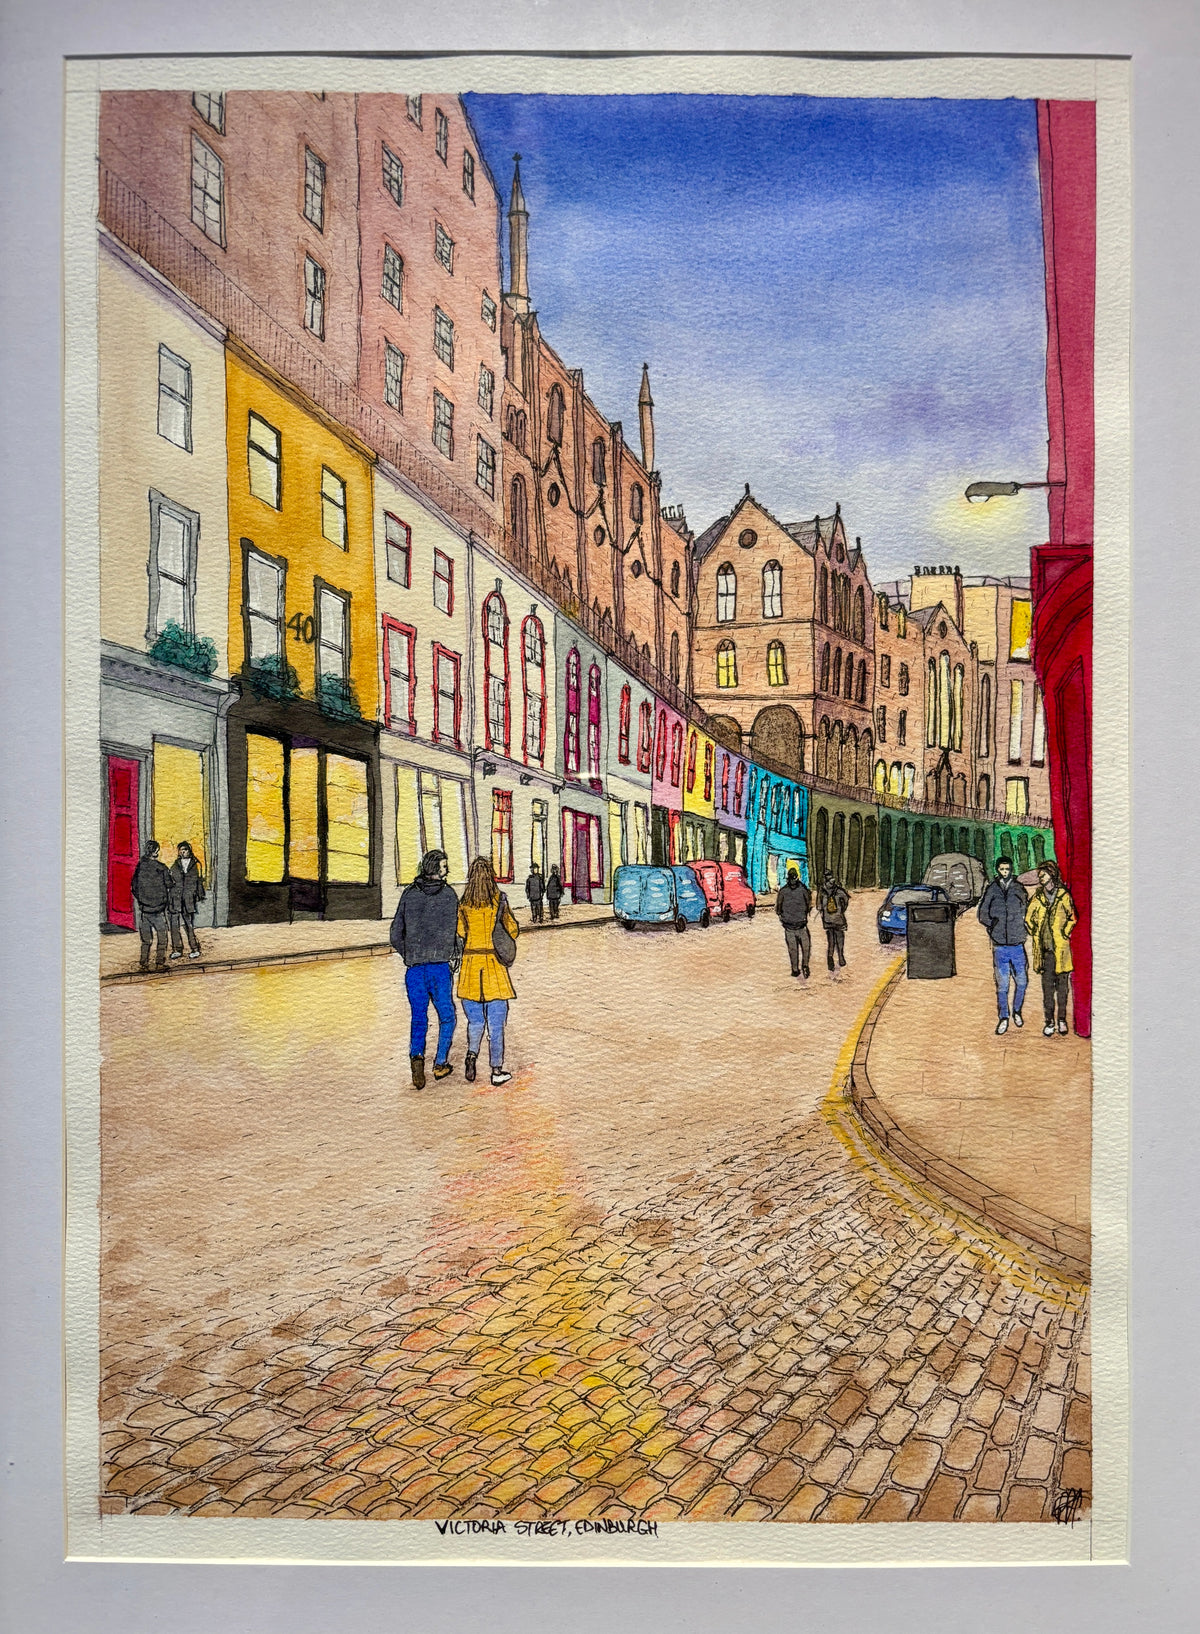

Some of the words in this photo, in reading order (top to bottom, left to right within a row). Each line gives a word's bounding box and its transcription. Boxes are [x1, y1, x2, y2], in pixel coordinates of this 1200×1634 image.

[287, 612, 316, 644] 40
[435, 1519, 507, 1535] VICTORIA
[575, 1518, 659, 1538] EDINBURGH
